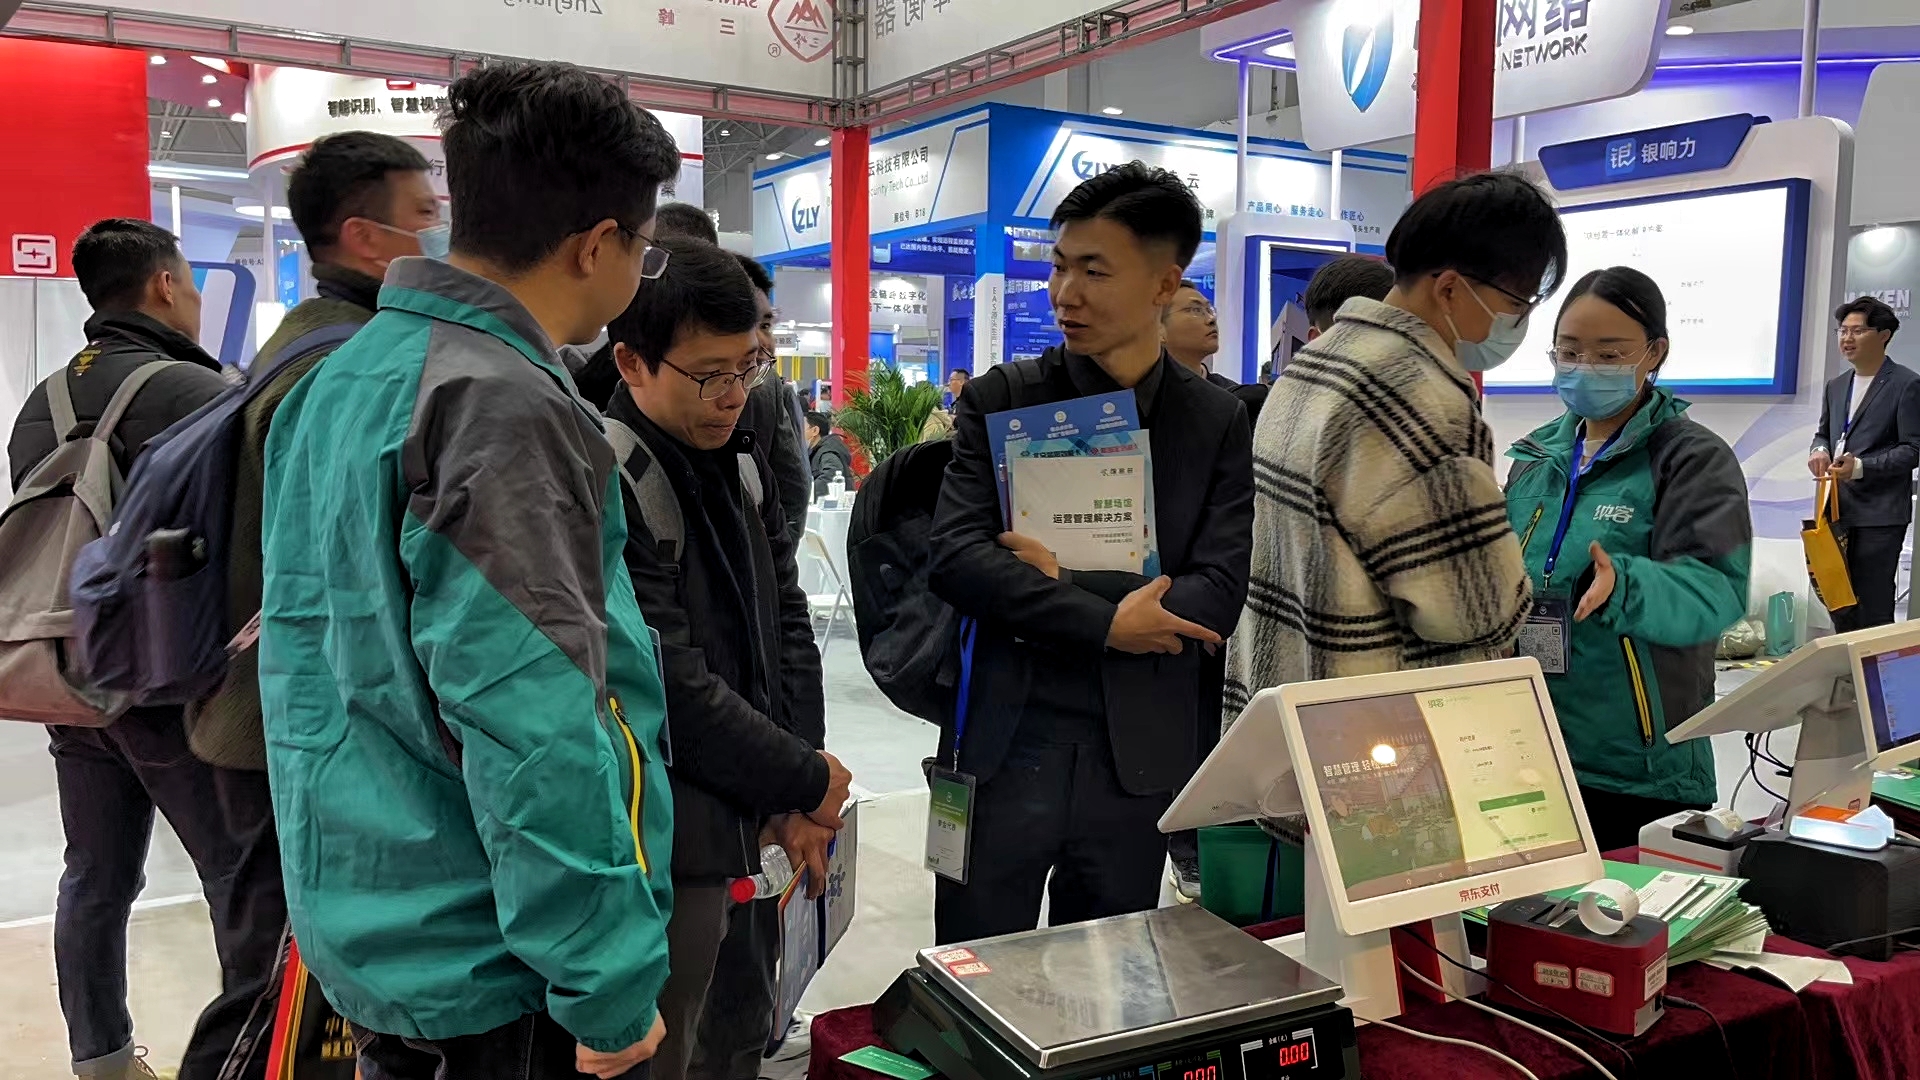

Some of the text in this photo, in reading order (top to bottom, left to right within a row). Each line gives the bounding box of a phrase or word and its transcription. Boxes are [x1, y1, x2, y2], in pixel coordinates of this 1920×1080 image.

[1500, 33, 1588, 71] NETWORK
[1641, 137, 1697, 164] 银响力
[1247, 201, 1282, 214] 产品用心
[1290, 204, 1324, 218] 服务走心
[1053, 511, 1133, 524] 运营管理解决方案
[1459, 883, 1500, 902] 京东支付
[1279, 1041, 1310, 1067] 0.00
